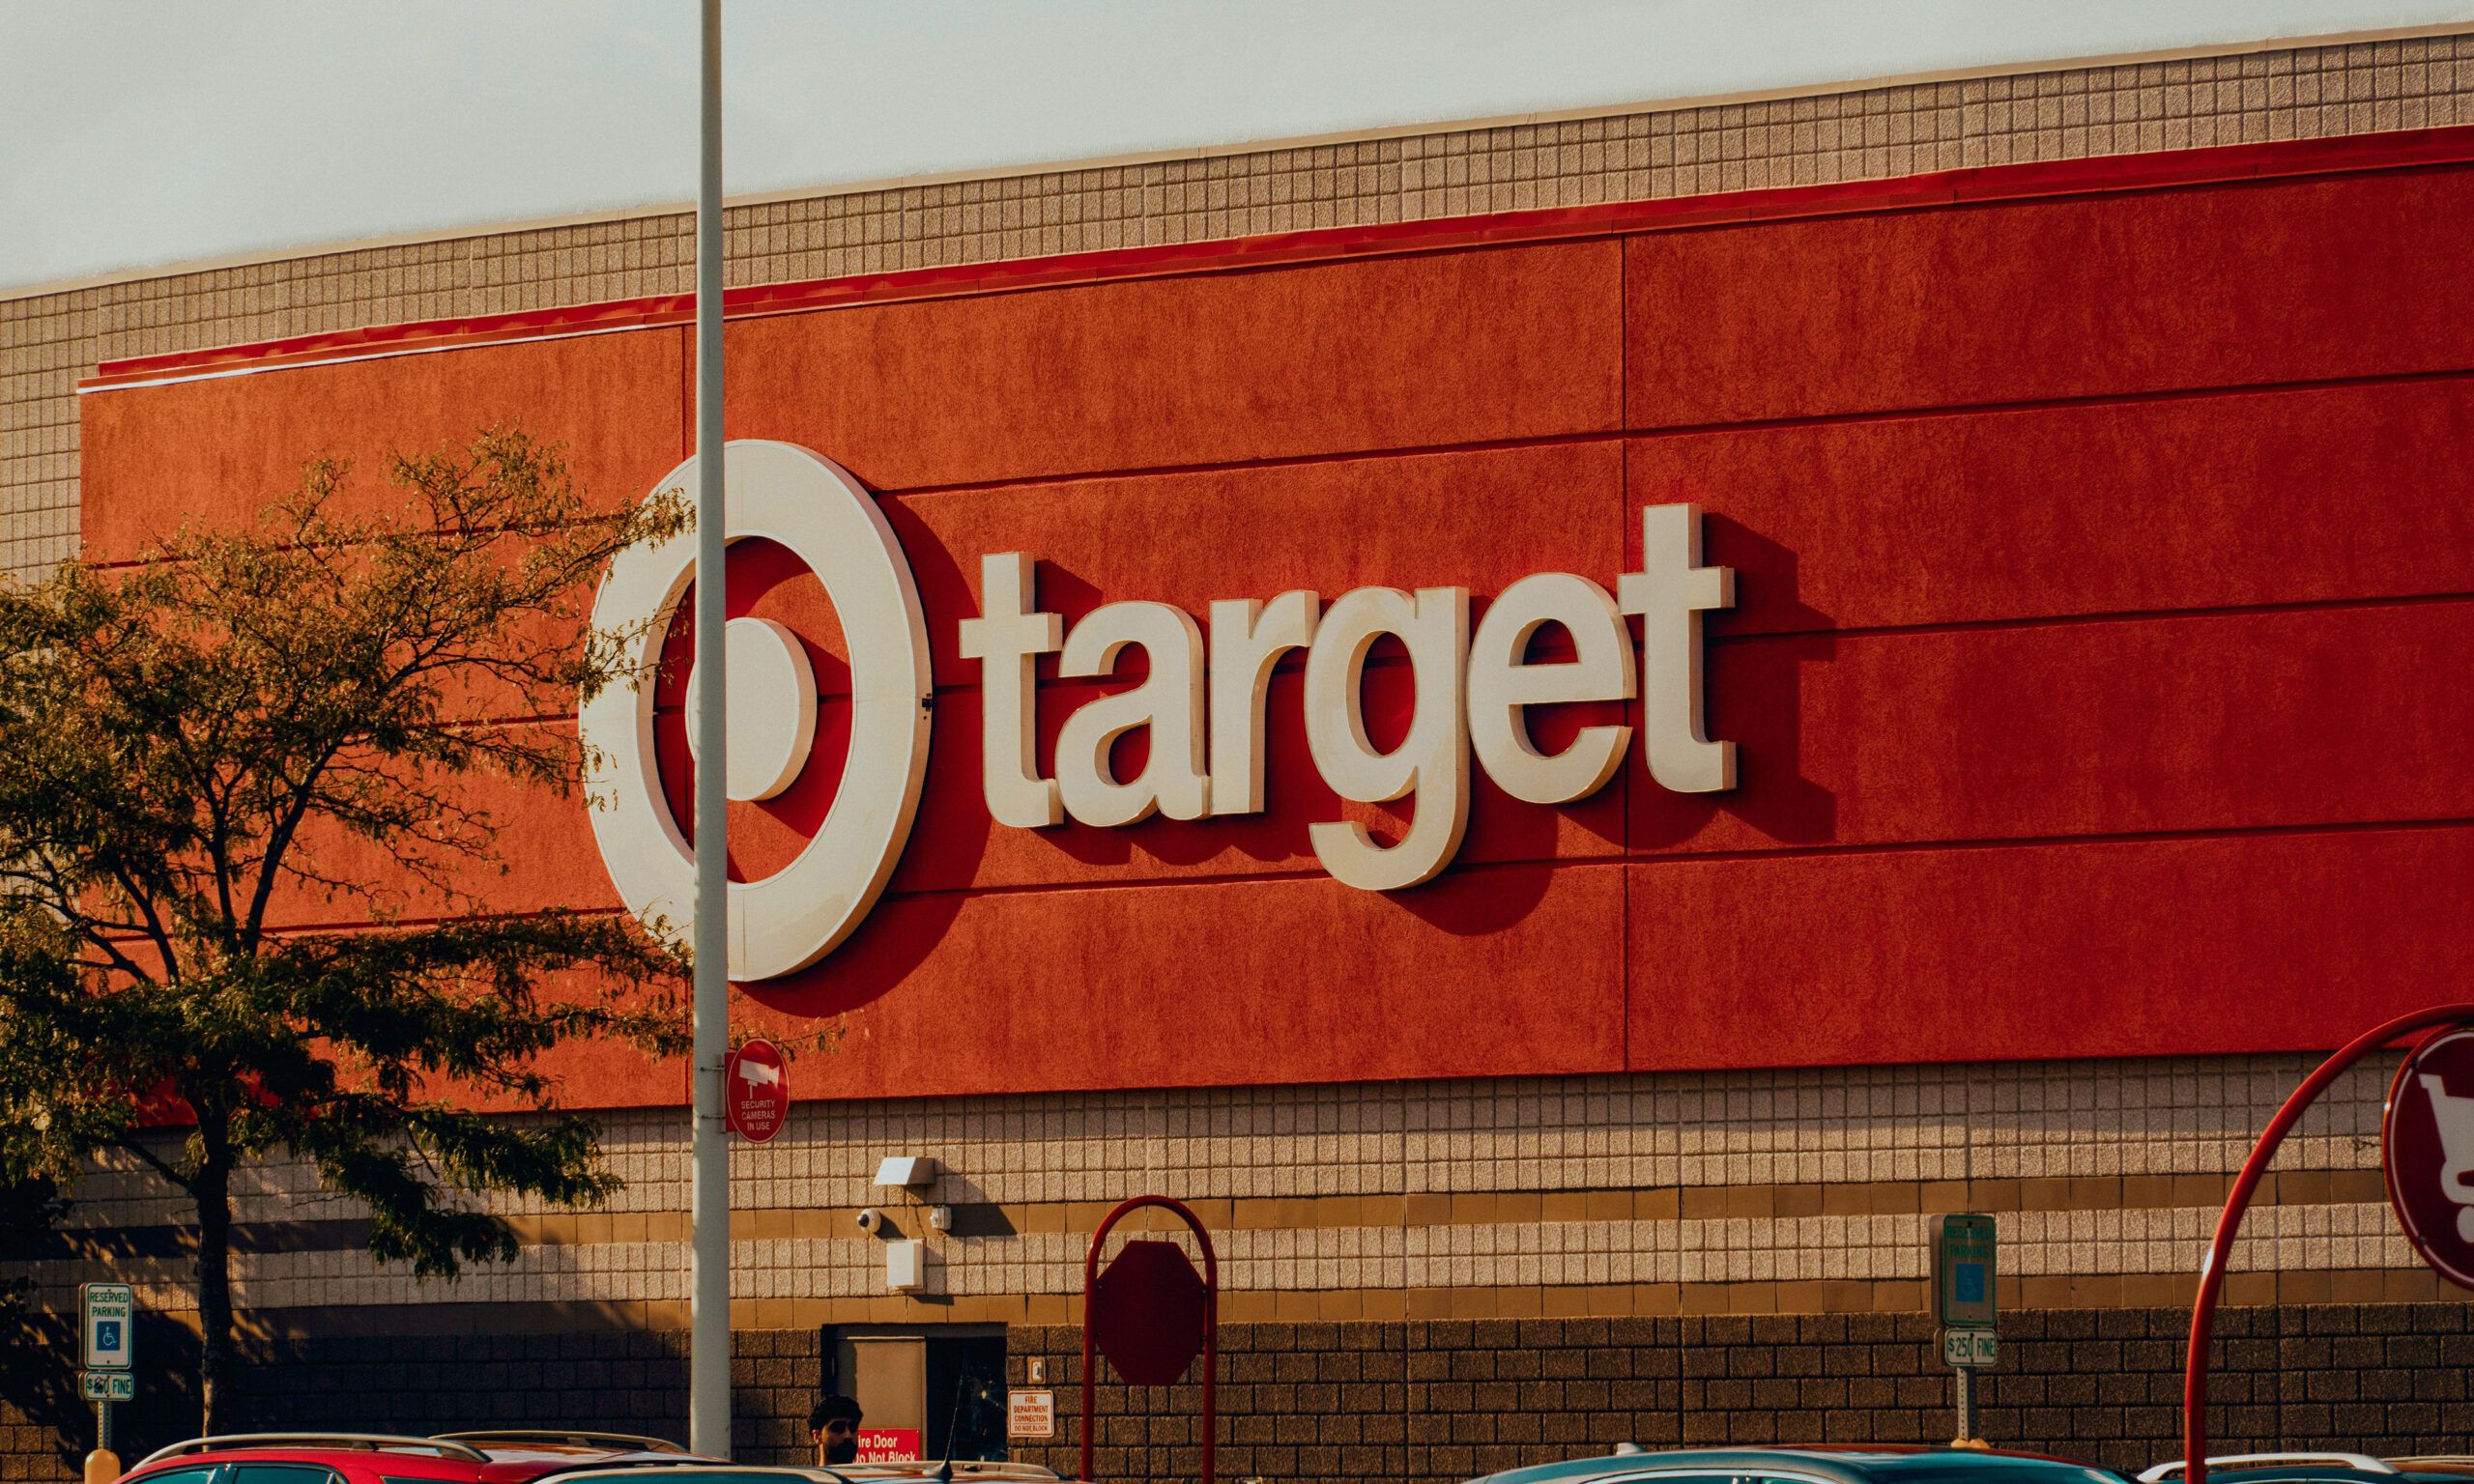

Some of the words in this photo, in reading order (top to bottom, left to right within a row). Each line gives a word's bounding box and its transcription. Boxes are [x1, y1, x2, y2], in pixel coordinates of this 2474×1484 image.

[959, 503, 1738, 891] target
[741, 1099, 775, 1109] SECURITY
[741, 1110, 776, 1121] CAMERAS
[747, 1122, 755, 1131] IN
[756, 1121, 770, 1130] USE
[1946, 1225, 1995, 1240] RESERVED
[1950, 1243, 1988, 1259] PARKING
[90, 1292, 129, 1302] RESERVED
[92, 1306, 126, 1317] PARKING
[1948, 1337, 1973, 1357] $250
[1976, 1338, 1995, 1357] FINE
[112, 1379, 132, 1394] FINE
[857, 1435, 871, 1448] ire
[874, 1435, 898, 1448] Door
[869, 1451, 885, 1464] Not
[889, 1450, 916, 1463] Block
